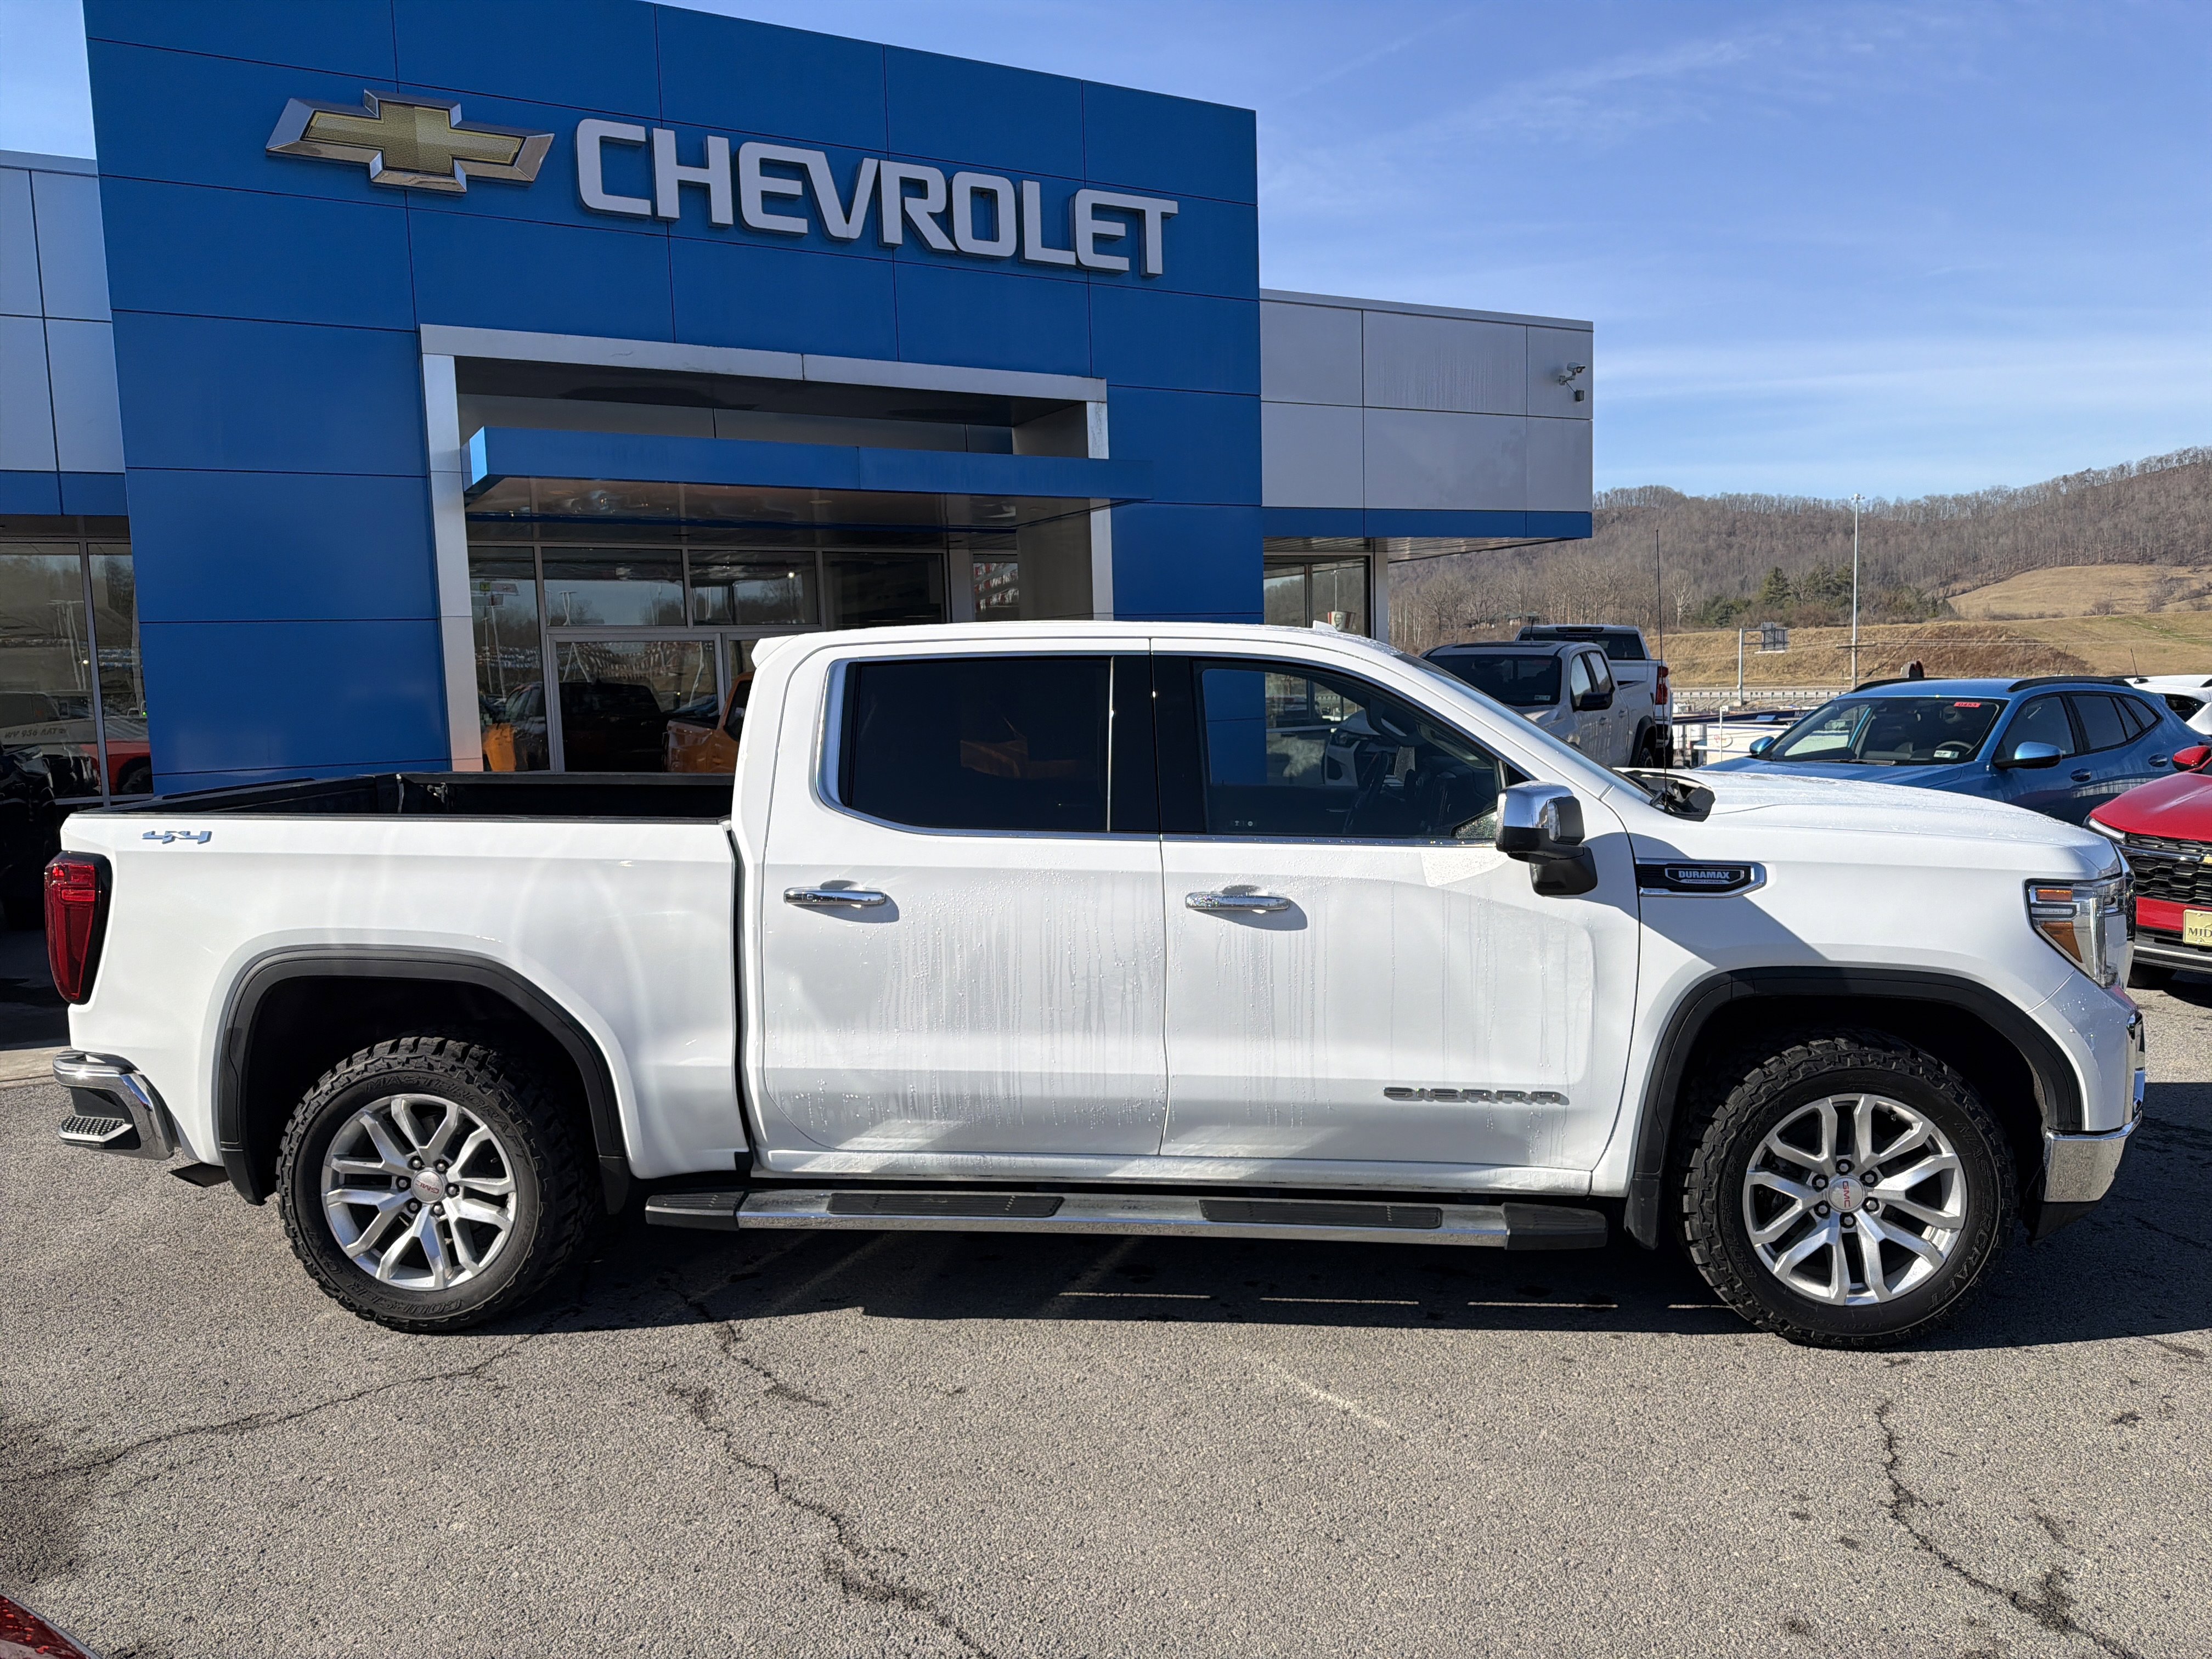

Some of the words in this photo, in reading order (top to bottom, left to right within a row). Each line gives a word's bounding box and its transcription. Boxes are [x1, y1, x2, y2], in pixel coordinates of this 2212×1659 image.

[574, 118, 1178, 277] CHEVROLET
[1678, 871, 1730, 879] DURAMAX
[1384, 1087, 1561, 1102] SIERRA
[415, 1180, 439, 1194] GMC
[1842, 1181, 1850, 1207] GMC
[1928, 1122, 1994, 1312] MASTERCRAFT
